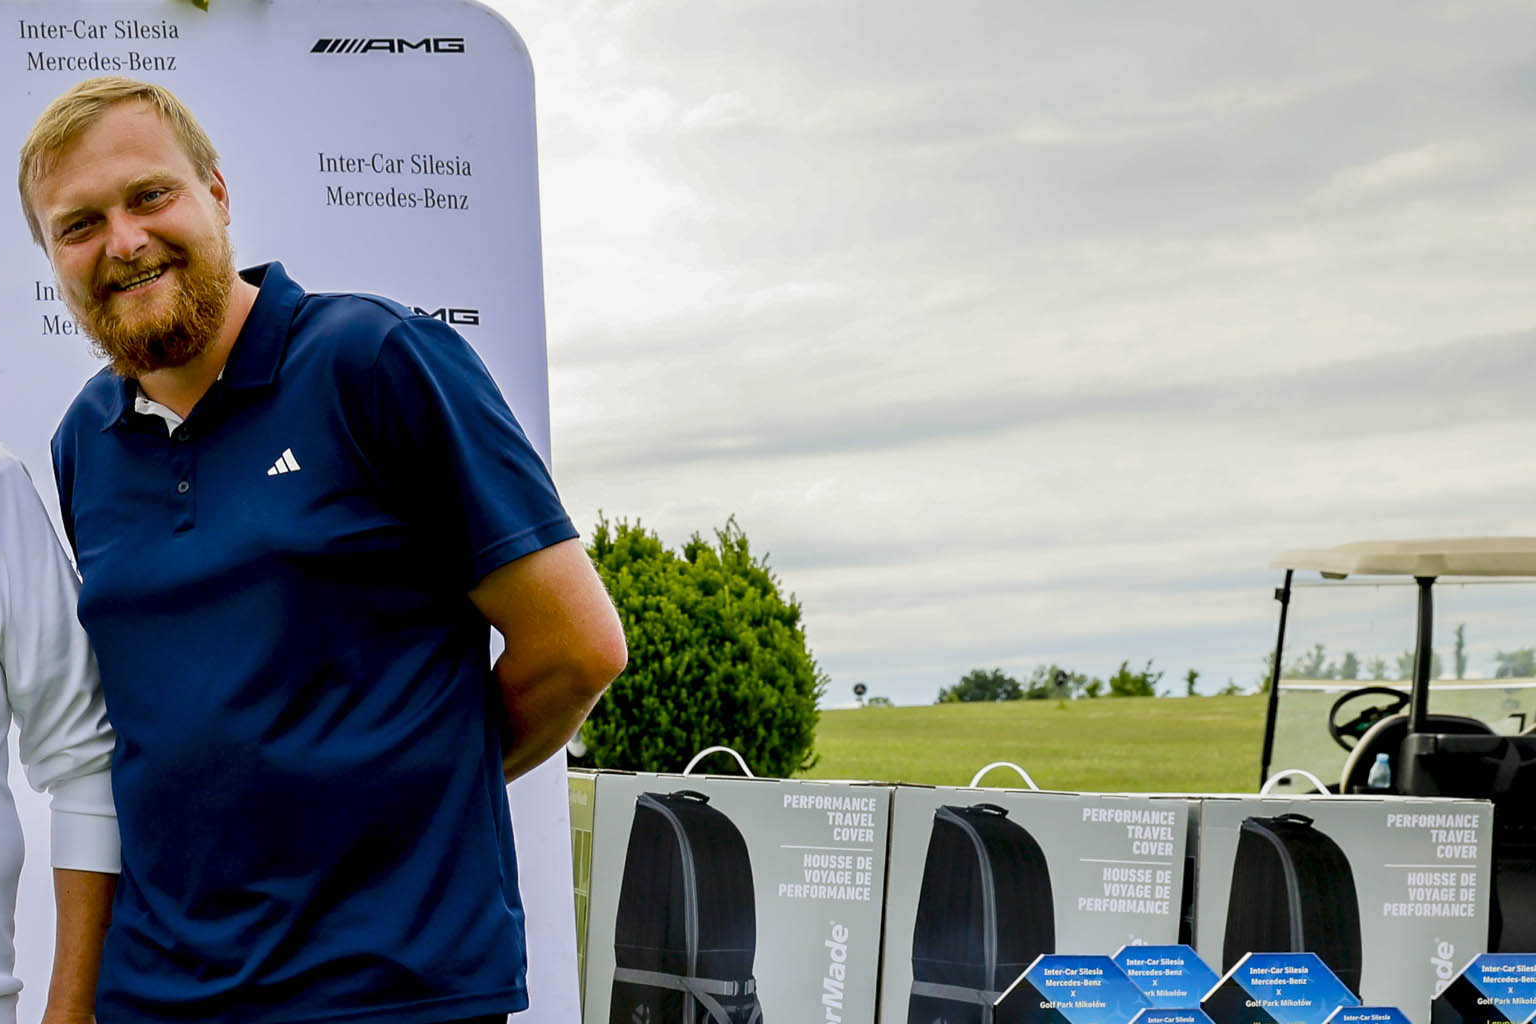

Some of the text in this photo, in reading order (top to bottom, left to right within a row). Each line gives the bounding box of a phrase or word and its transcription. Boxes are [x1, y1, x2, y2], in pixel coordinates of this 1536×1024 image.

[19, 20, 179, 39] Inter-Car Silesia
[364, 38, 464, 53] AMG
[27, 52, 176, 71] Mercedes-Benz
[318, 153, 471, 176] Inter-Car Silesia
[326, 186, 468, 209] Mercedes-Benz
[784, 794, 876, 812] PERFORMANCE
[827, 812, 875, 827] TRAVEL
[1082, 808, 1175, 825] PERFORMANCE
[1387, 814, 1479, 828] PERFORMANCE
[833, 828, 874, 842] COVER
[1127, 825, 1174, 840] TRAVEL
[1431, 830, 1477, 843] TRAVEL
[1133, 841, 1174, 856] COVER
[1437, 845, 1477, 858] COVER
[804, 854, 872, 870] HOUSSE DE
[804, 870, 871, 885] VOYAGE DE
[1103, 868, 1172, 884] HOUSSE DE
[1408, 872, 1476, 886] HOUSSE DE
[778, 884, 870, 900] PERFORMANCE
[1104, 883, 1171, 899] VOYAGE DE
[1408, 888, 1476, 901] VOYAGE DE
[1078, 897, 1169, 914] PERFORMANCE
[1383, 903, 1475, 917] PERFORMANCE
[1044, 968, 1103, 976] Inter-Car Silesia
[1481, 965, 1516, 973] Inter-Car
[1045, 979, 1101, 987] Mercedes-Benz
[1040, 1001, 1056, 1009] Golf
[1245, 1000, 1279, 1008] Golf Park
